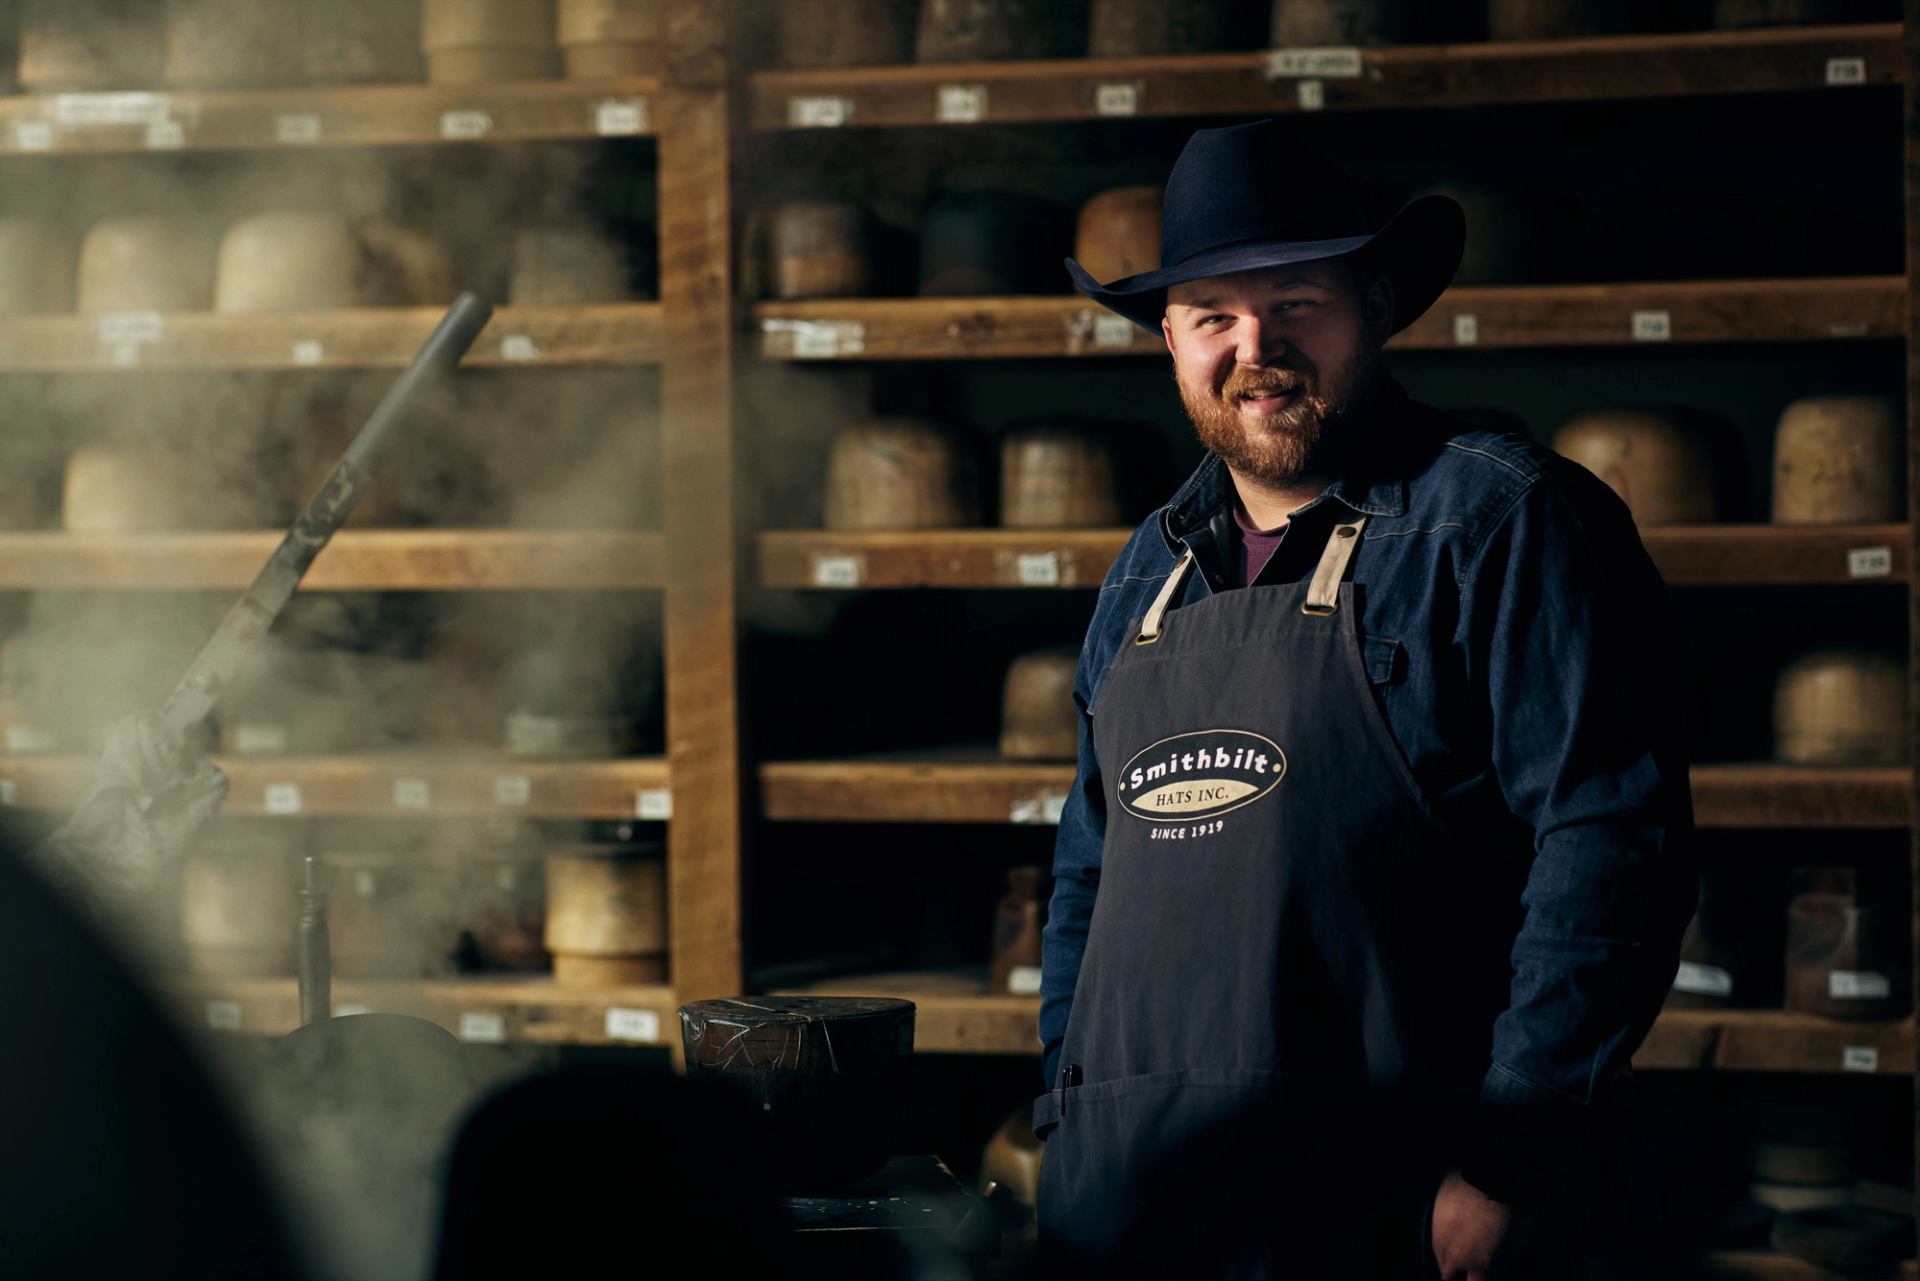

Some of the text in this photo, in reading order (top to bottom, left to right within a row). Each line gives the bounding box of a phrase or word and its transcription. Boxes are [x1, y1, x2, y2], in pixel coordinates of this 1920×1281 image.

[1130, 747, 1268, 789] Smithbilt
[1156, 787, 1229, 806] HATS INC.
[1151, 820, 1224, 840] SINCE 1919
